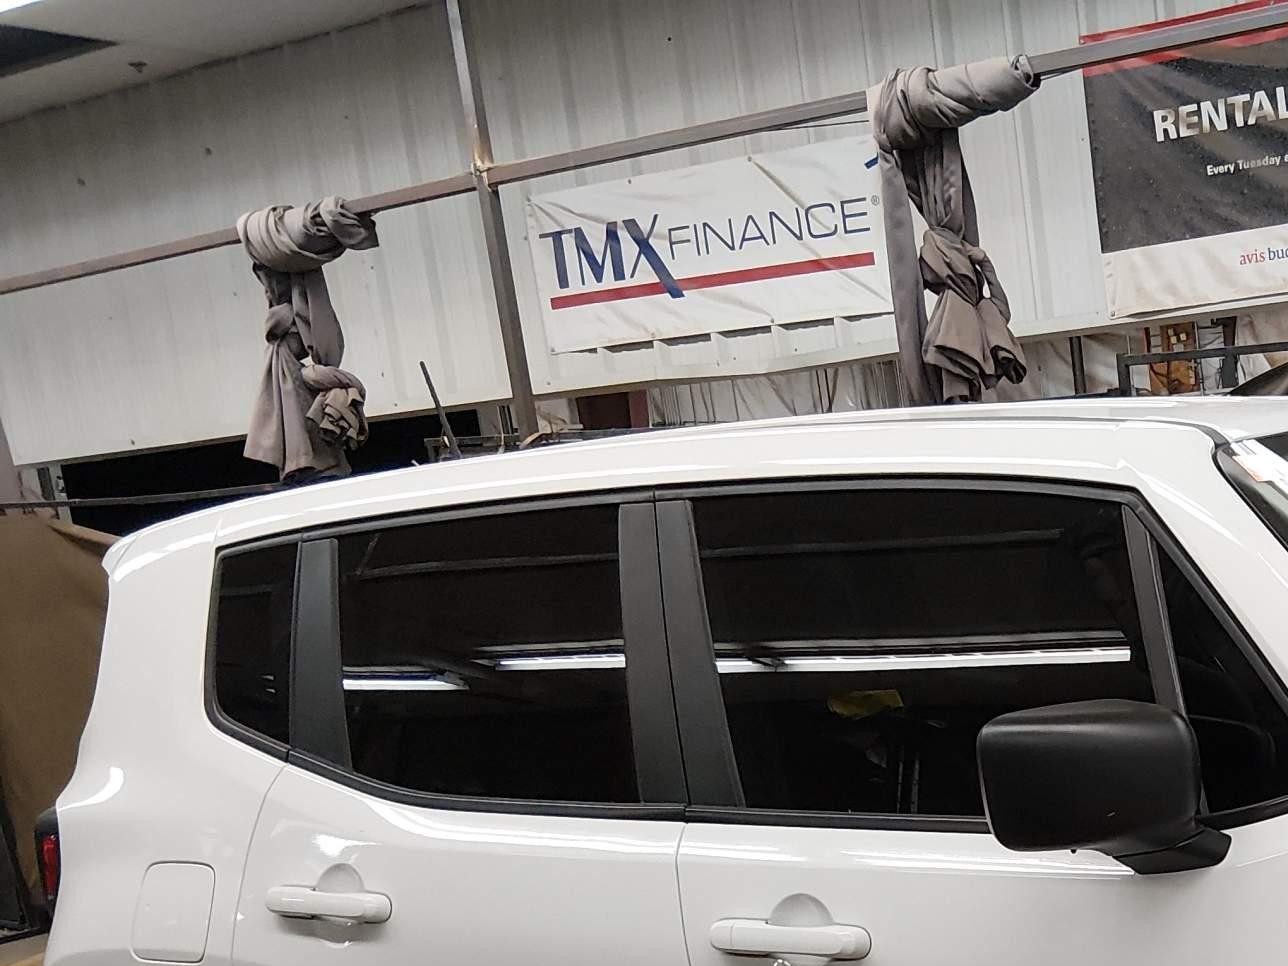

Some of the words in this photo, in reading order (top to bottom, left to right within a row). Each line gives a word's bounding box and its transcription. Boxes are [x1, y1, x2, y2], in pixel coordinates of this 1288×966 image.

[1206, 160, 1235, 177] Every
[1237, 154, 1281, 172] Tuesday
[538, 213, 686, 299] TMX
[667, 196, 872, 261] FINANCE
[1238, 249, 1266, 267] avis
